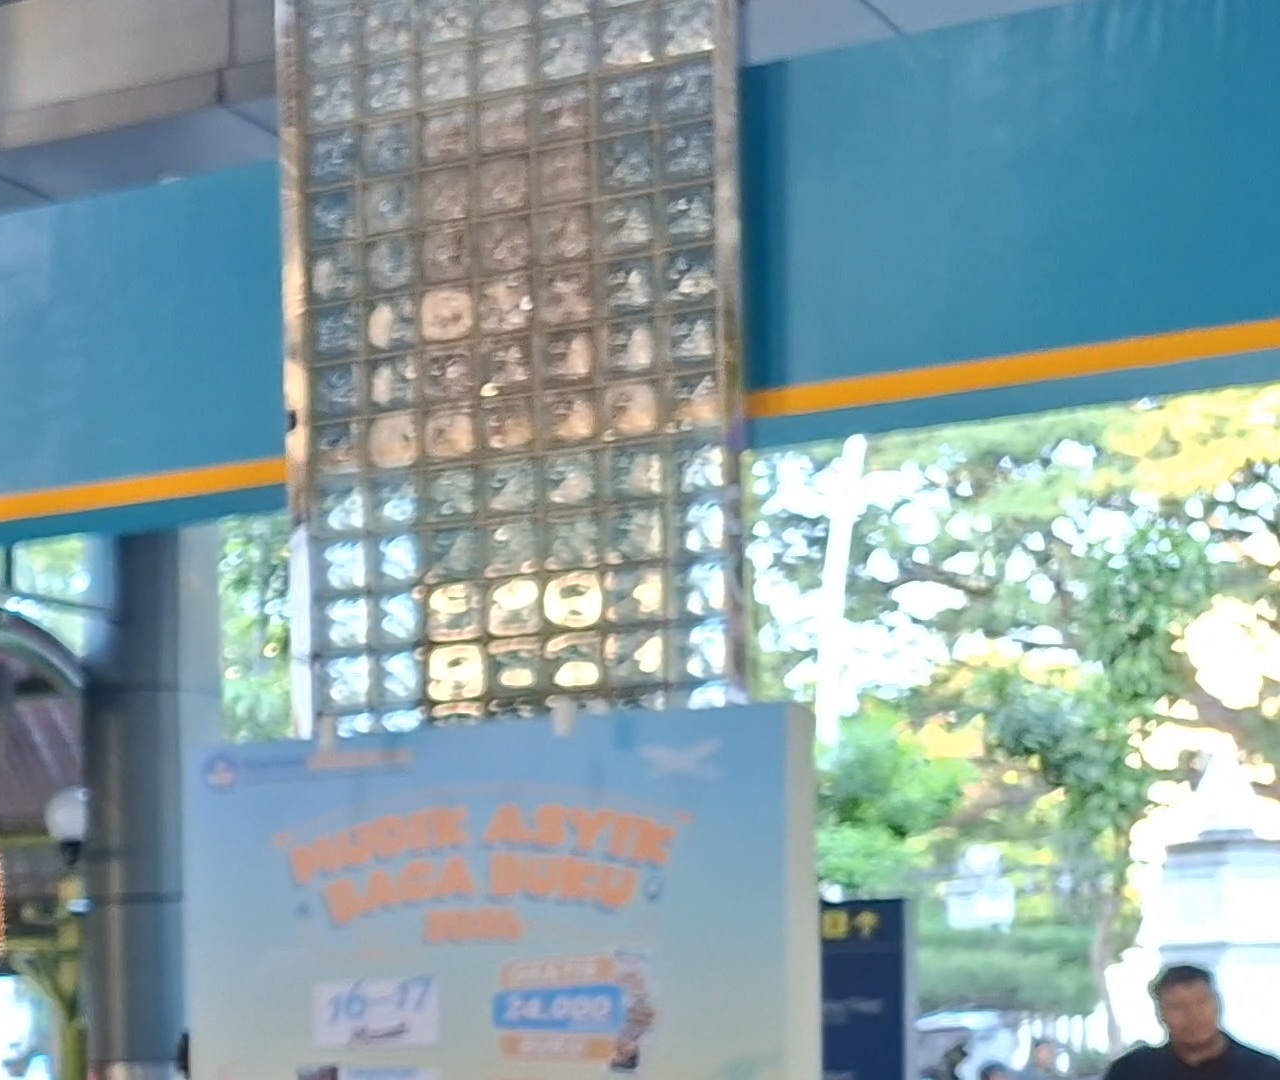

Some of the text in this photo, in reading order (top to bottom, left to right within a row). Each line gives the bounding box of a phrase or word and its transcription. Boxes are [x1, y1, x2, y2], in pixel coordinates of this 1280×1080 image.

[292, 804, 677, 884] MUDIK ASYIK
[325, 853, 638, 924] BACA BUKU
